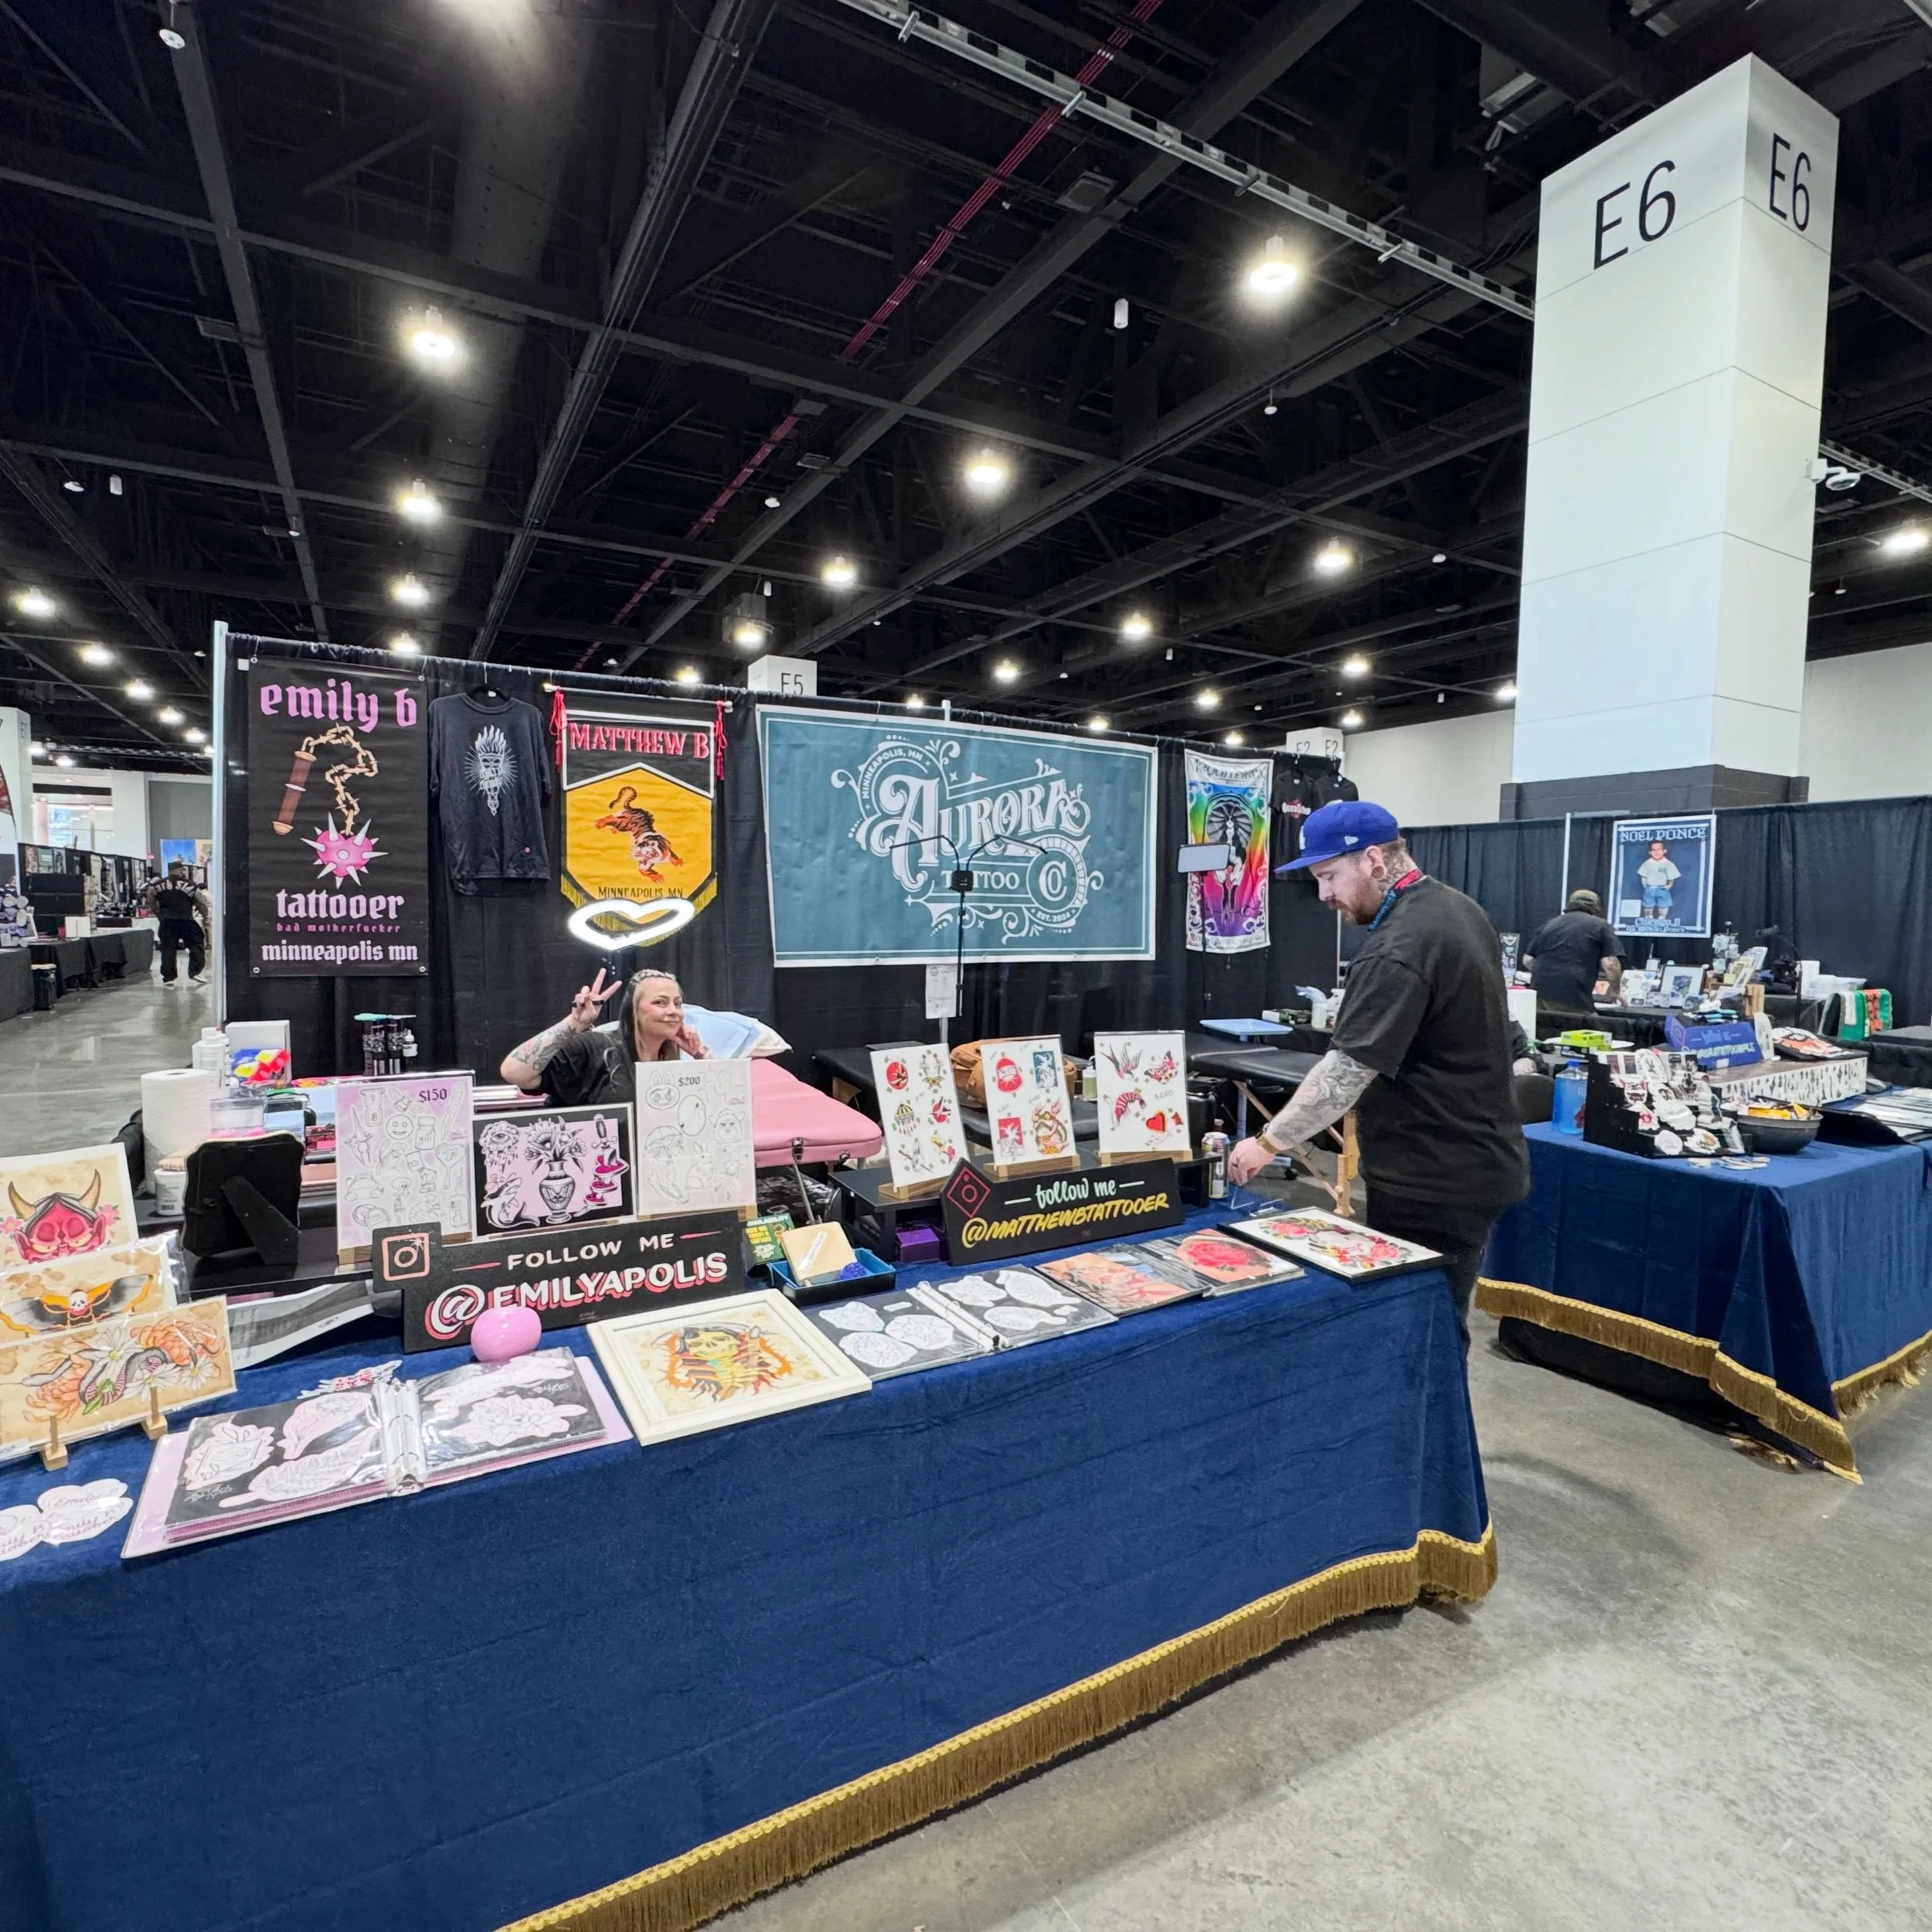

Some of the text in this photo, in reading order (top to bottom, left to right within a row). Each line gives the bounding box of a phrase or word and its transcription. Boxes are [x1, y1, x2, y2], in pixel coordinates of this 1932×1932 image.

[1769, 132, 1811, 232] E6
[1593, 159, 1676, 270] E6
[260, 678, 379, 733] emily
[568, 723, 710, 759] MATTHEW B
[870, 774, 1091, 889] AURORA
[1619, 827, 1707, 843] NOEL PONCE
[597, 886, 664, 899] MINNEAPOLIS
[940, 870, 1020, 889] TTTOO
[276, 889, 405, 920] tattooer
[261, 939, 419, 965] minneapolis mn
[418, 1088, 447, 1104] $150
[678, 1077, 701, 1087] $200
[1034, 1177, 1117, 1209] follow me
[961, 1192, 1169, 1249] @MATTHEWBTATTOOER
[507, 1233, 675, 1271] FOLLOW ME
[425, 1252, 728, 1338] @EMILYAPOLIS
